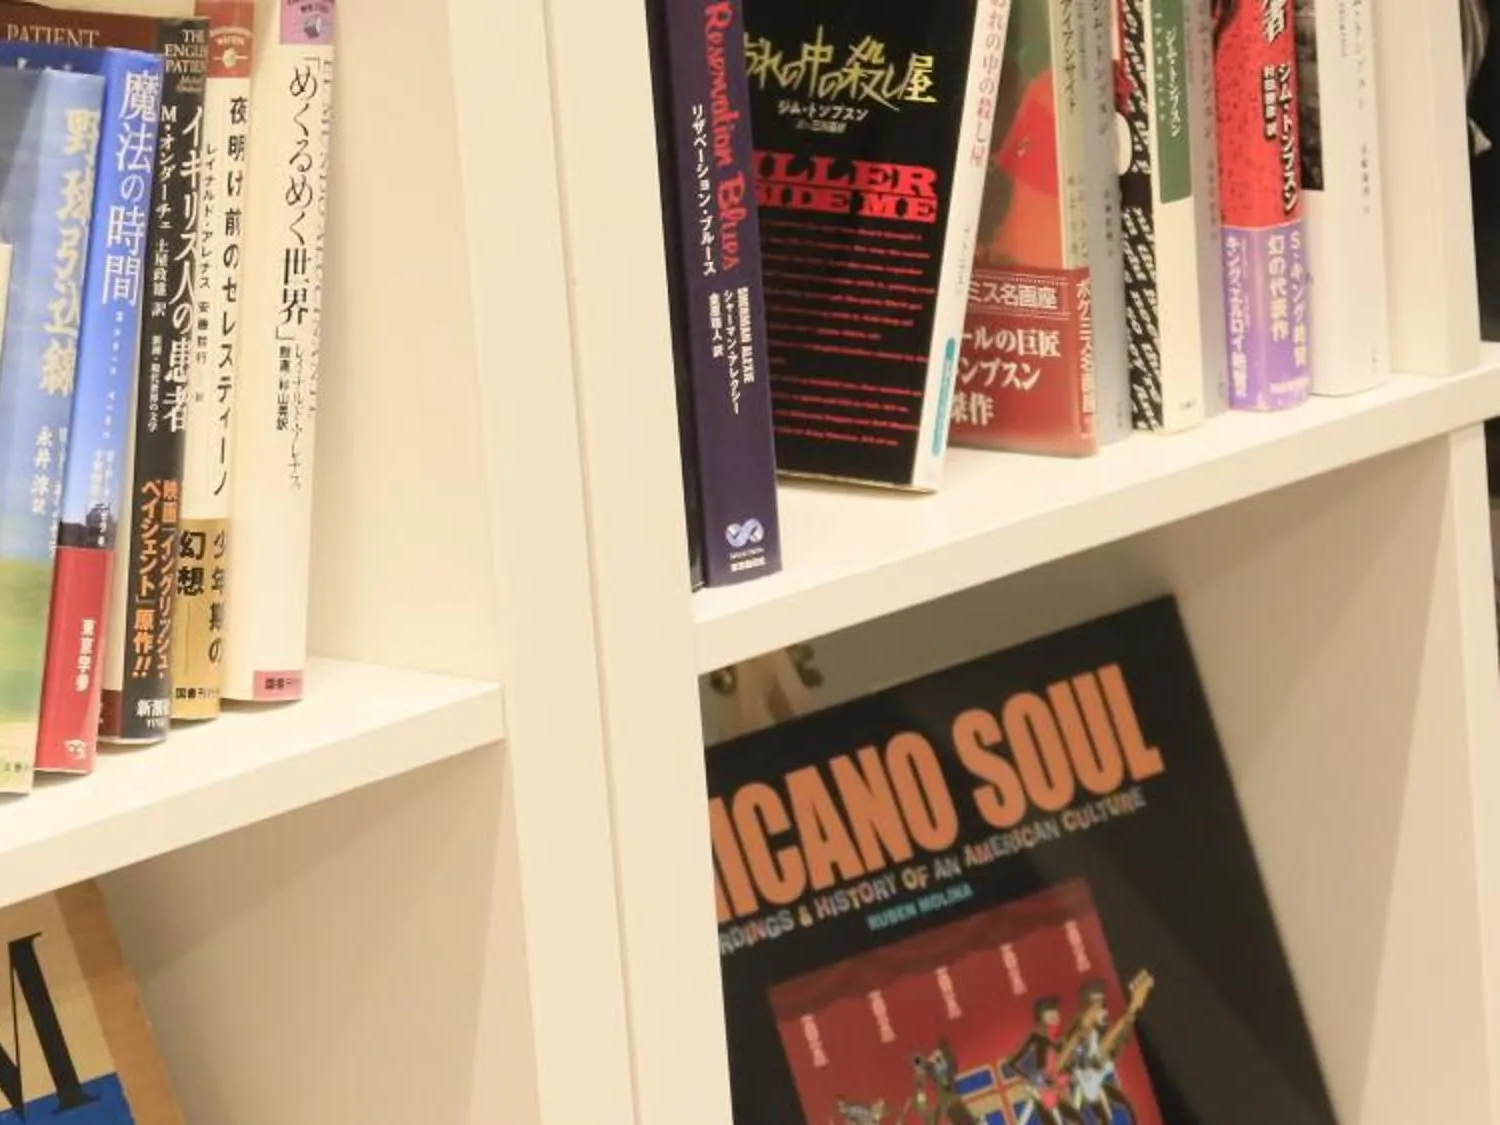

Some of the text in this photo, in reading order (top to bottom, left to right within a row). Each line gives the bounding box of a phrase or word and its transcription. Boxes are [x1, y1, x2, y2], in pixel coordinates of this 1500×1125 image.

[5, 26, 101, 49] PATIENT
[969, 0, 1006, 168] れの中の殺し屋
[101, 69, 161, 307] 魔法の時間
[691, 103, 718, 277] リザベーション・ブルース
[751, 151, 938, 199] ILLER
[1276, 62, 1297, 216] ジム・トンプスン
[857, 190, 938, 224] ME
[162, 104, 204, 433] イギリス人の患者
[967, 281, 1059, 311] ミス名画座
[956, 357, 1041, 391] ンプスン
[962, 325, 1061, 358] ールの巨匠
[177, 529, 207, 597] 幻想
[708, 663, 1165, 923] ICANO SOUL
[719, 908, 795, 956] RDINGS
[813, 872, 897, 919] HISTORY
[902, 863, 929, 891] OF
[933, 855, 962, 881] AN
[963, 817, 1062, 868] AMERICAN
[1061, 784, 1148, 832] CULTURE
